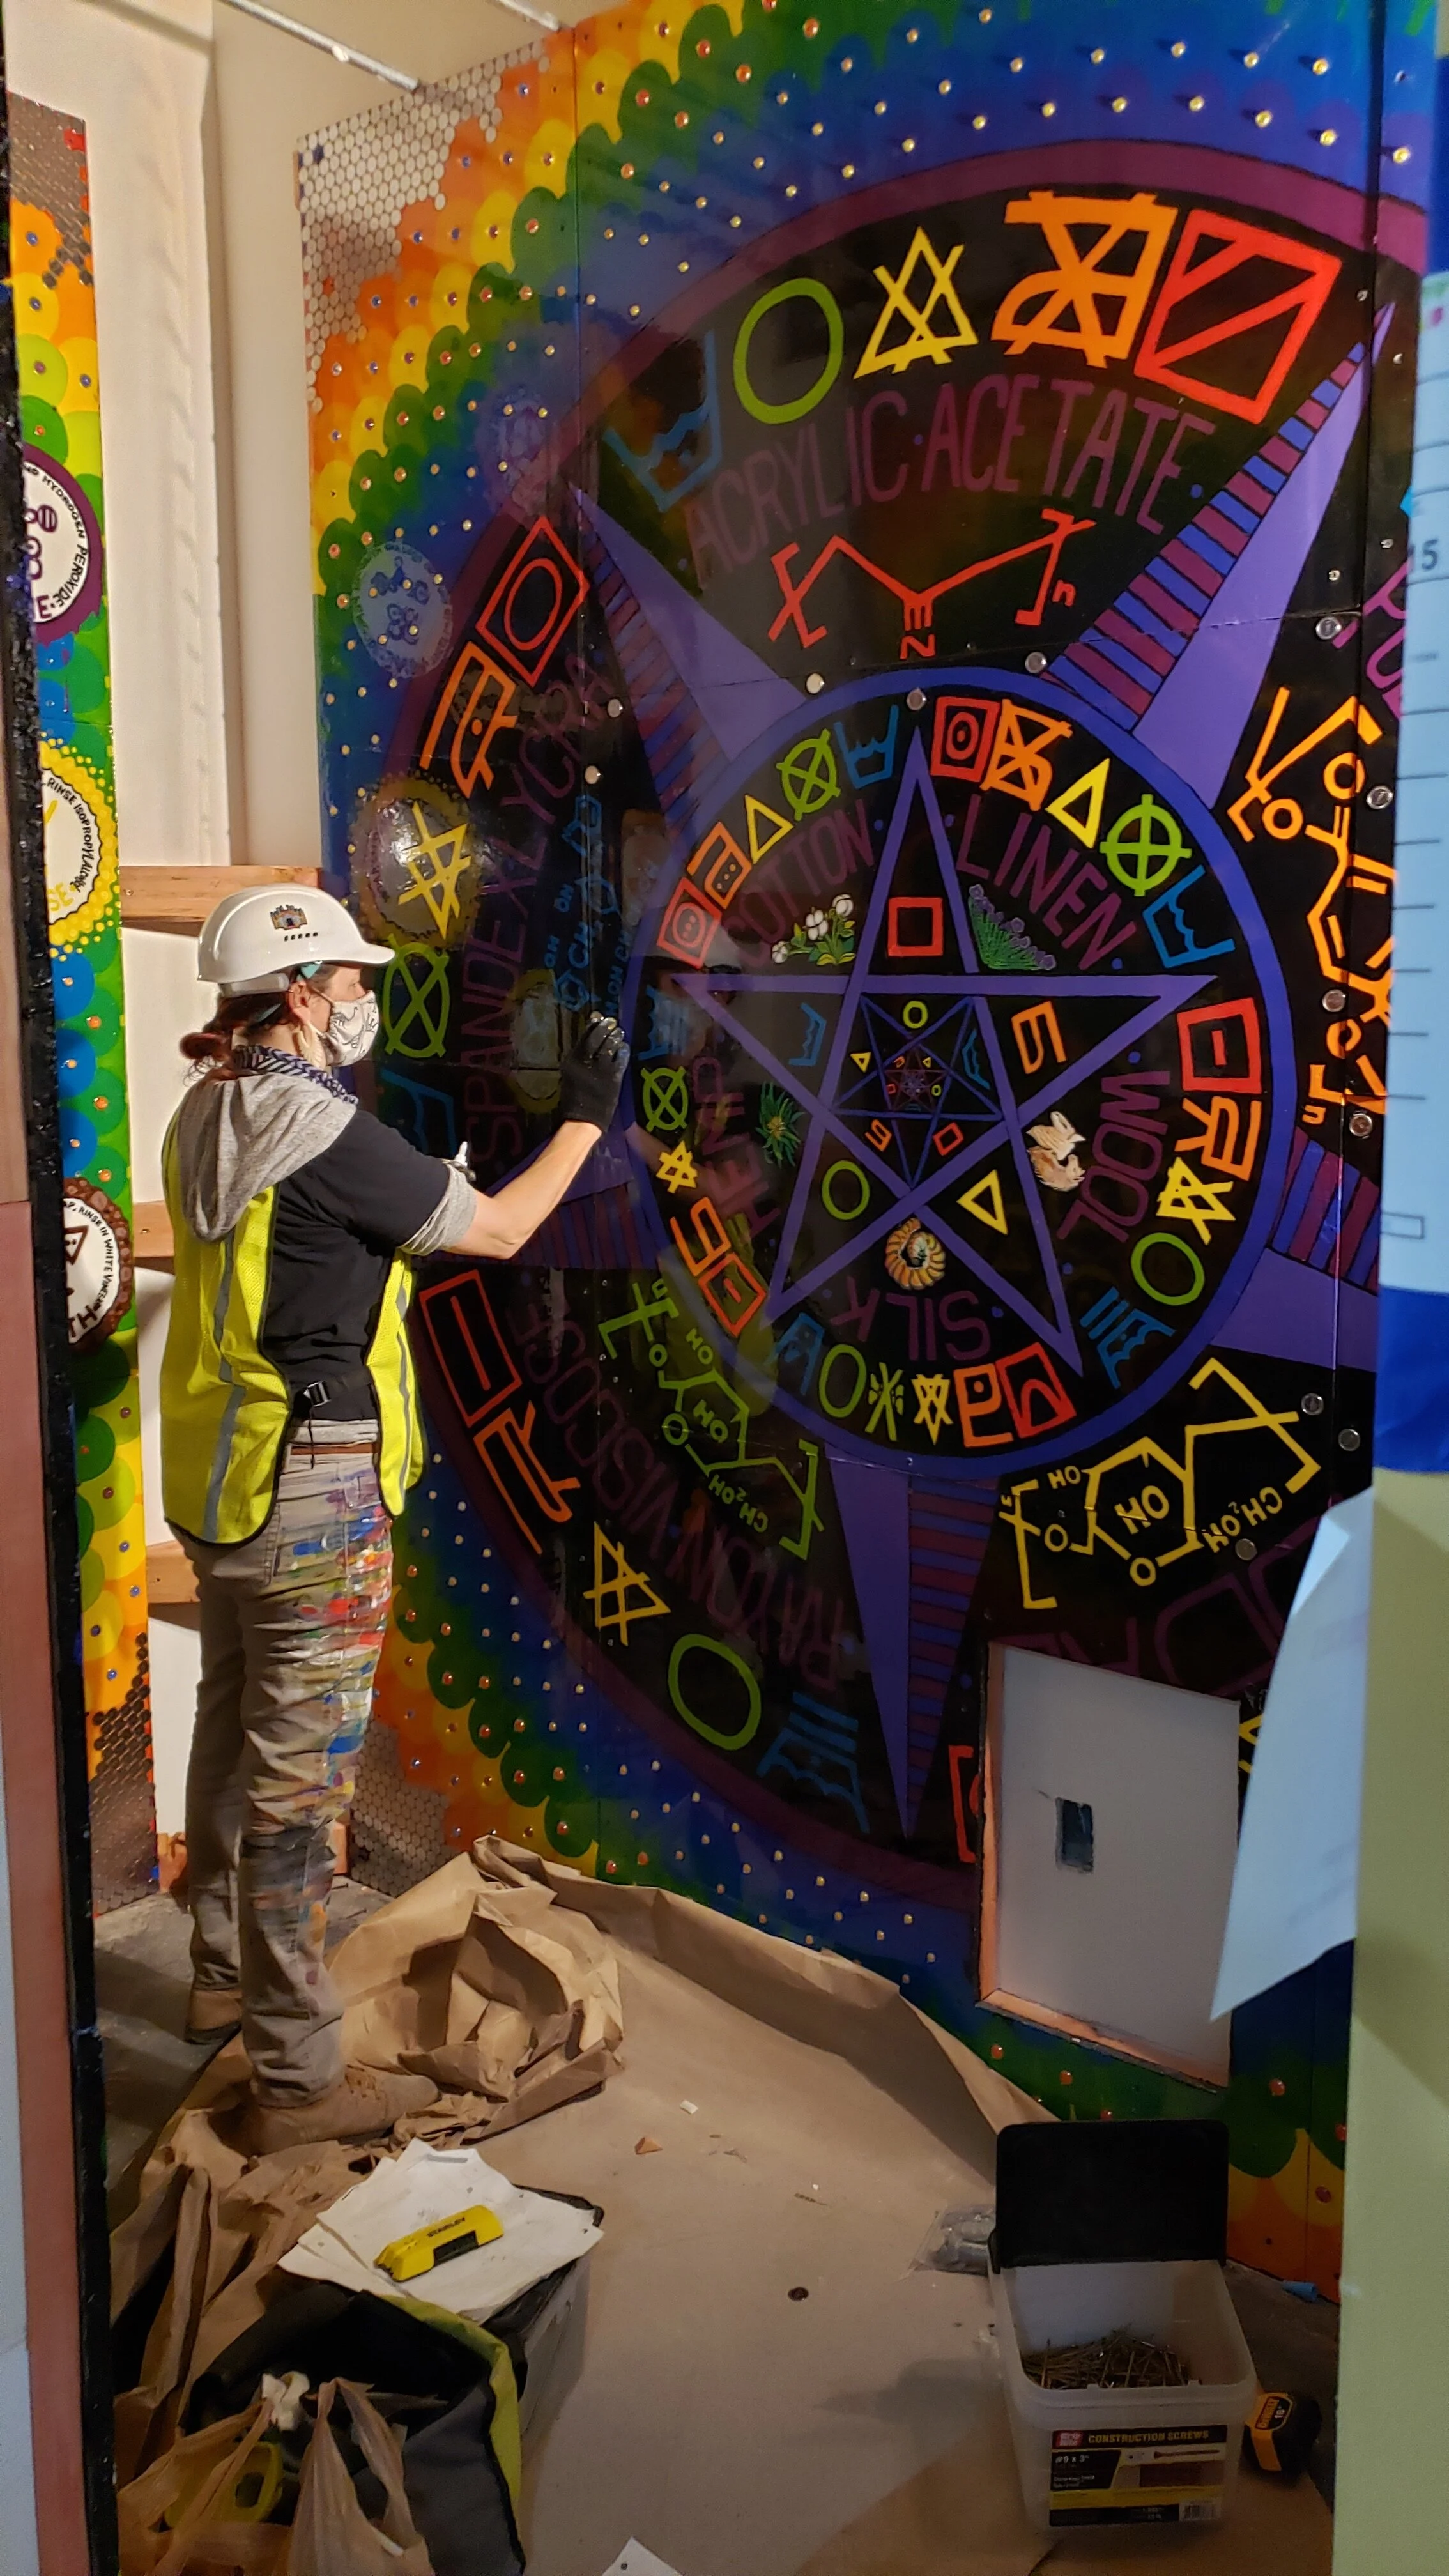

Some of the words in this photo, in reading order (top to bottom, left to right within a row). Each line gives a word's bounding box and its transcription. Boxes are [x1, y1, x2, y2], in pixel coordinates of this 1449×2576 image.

[42, 477, 85, 539] HYDROGEN
[685, 388, 908, 589] ACRYLIC
[921, 373, 1215, 535] ACETATE
[53, 544, 88, 607] PEROXIDE
[47, 777, 77, 806] RINSE
[724, 798, 876, 968] COTTON
[956, 793, 1137, 970] LINEN
[459, 873, 537, 1162] SPANDEX
[691, 1057, 781, 1237] HEMP
[1057, 1071, 1170, 1243] WOOL
[104, 1240, 114, 1275] WHITE
[831, 1275, 992, 1363] SILK
[667, 1525, 847, 1692] RAYON
[1087, 2432, 1165, 2444] CONSTRUCTION
[1167, 2429, 1209, 2441] SCREWS
